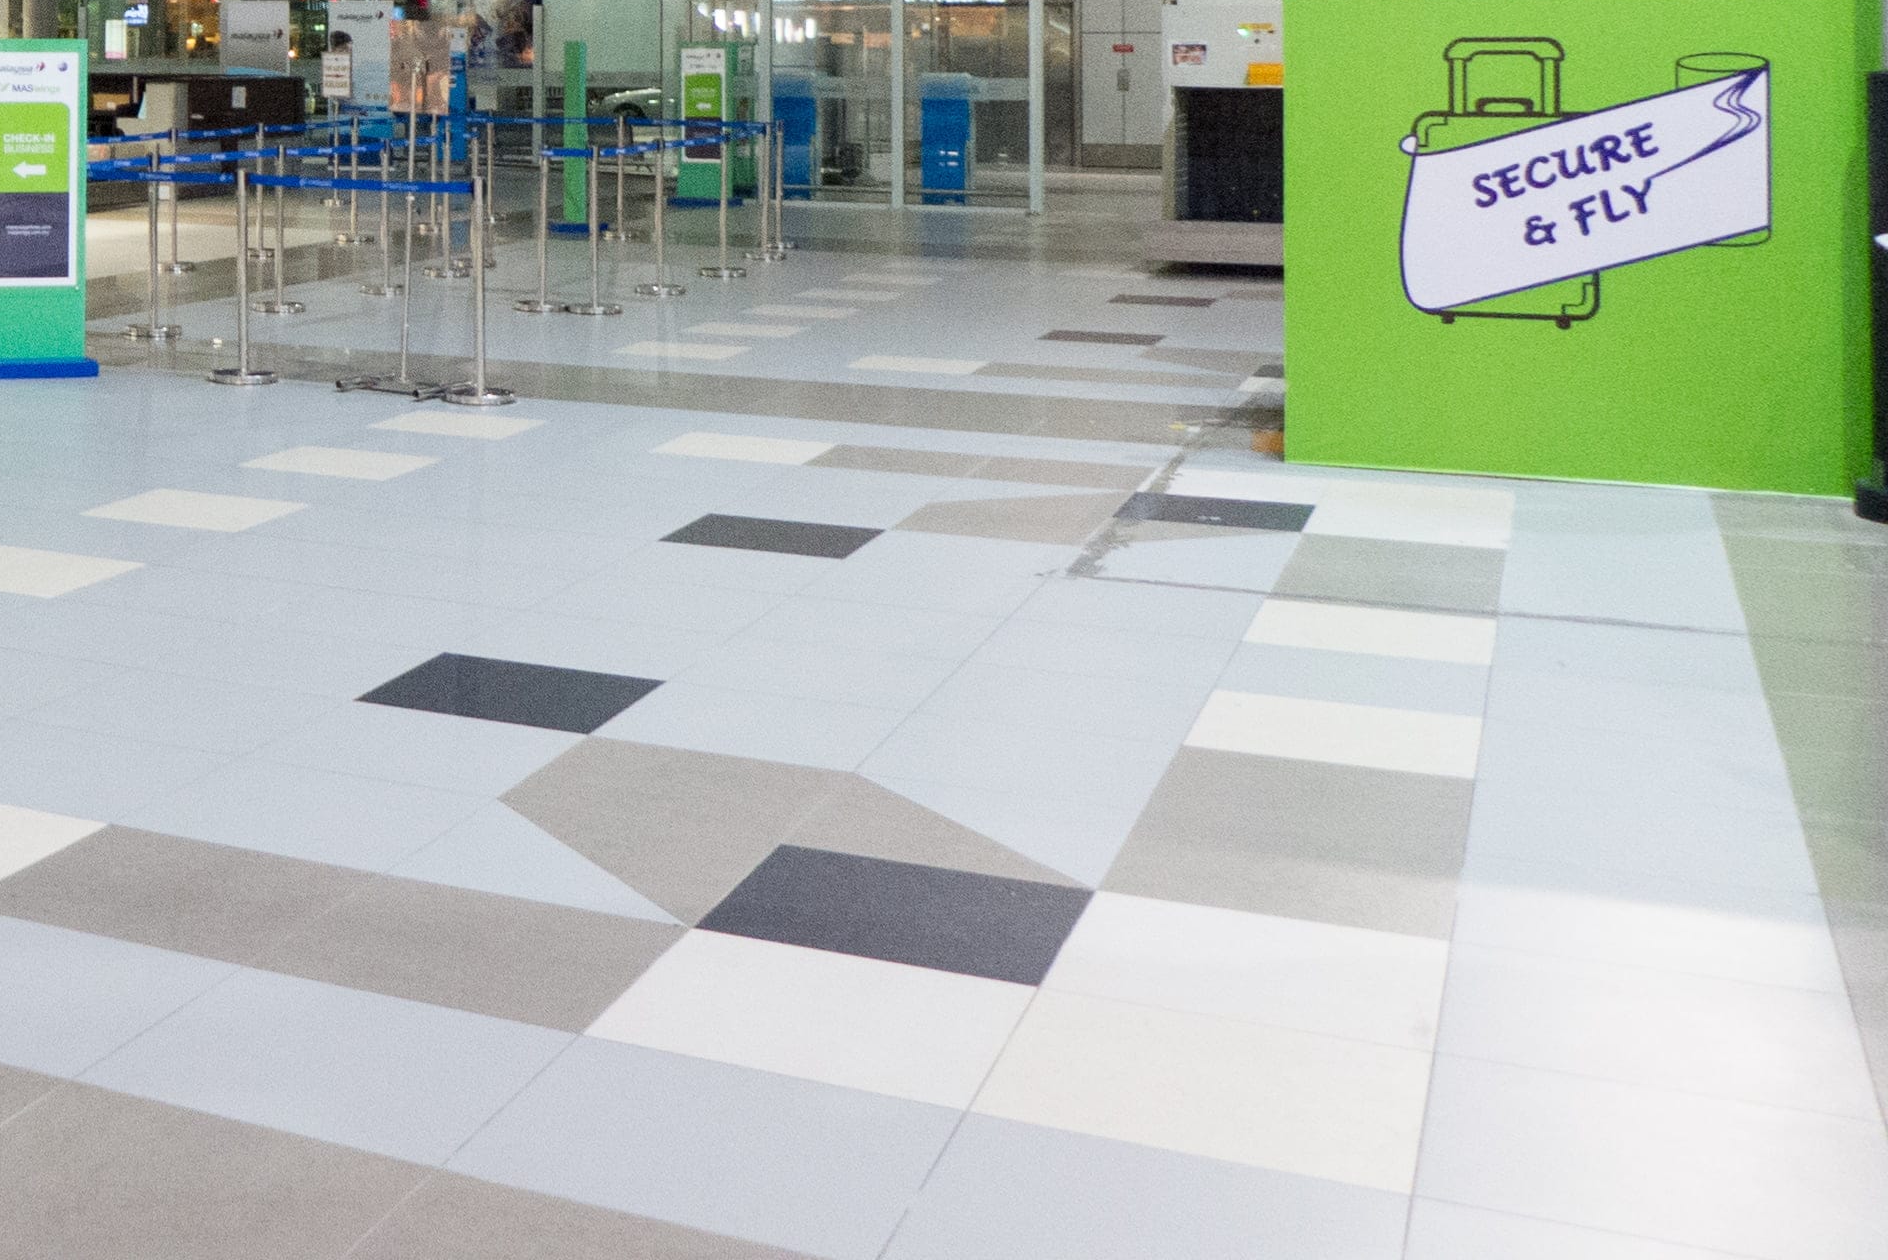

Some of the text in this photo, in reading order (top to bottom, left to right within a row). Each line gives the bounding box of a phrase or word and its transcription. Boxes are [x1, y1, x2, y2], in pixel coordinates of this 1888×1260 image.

[3, 133, 56, 143] CHECK-IN
[1472, 122, 1660, 208] SECURE
[1523, 177, 1653, 246] & FLY
